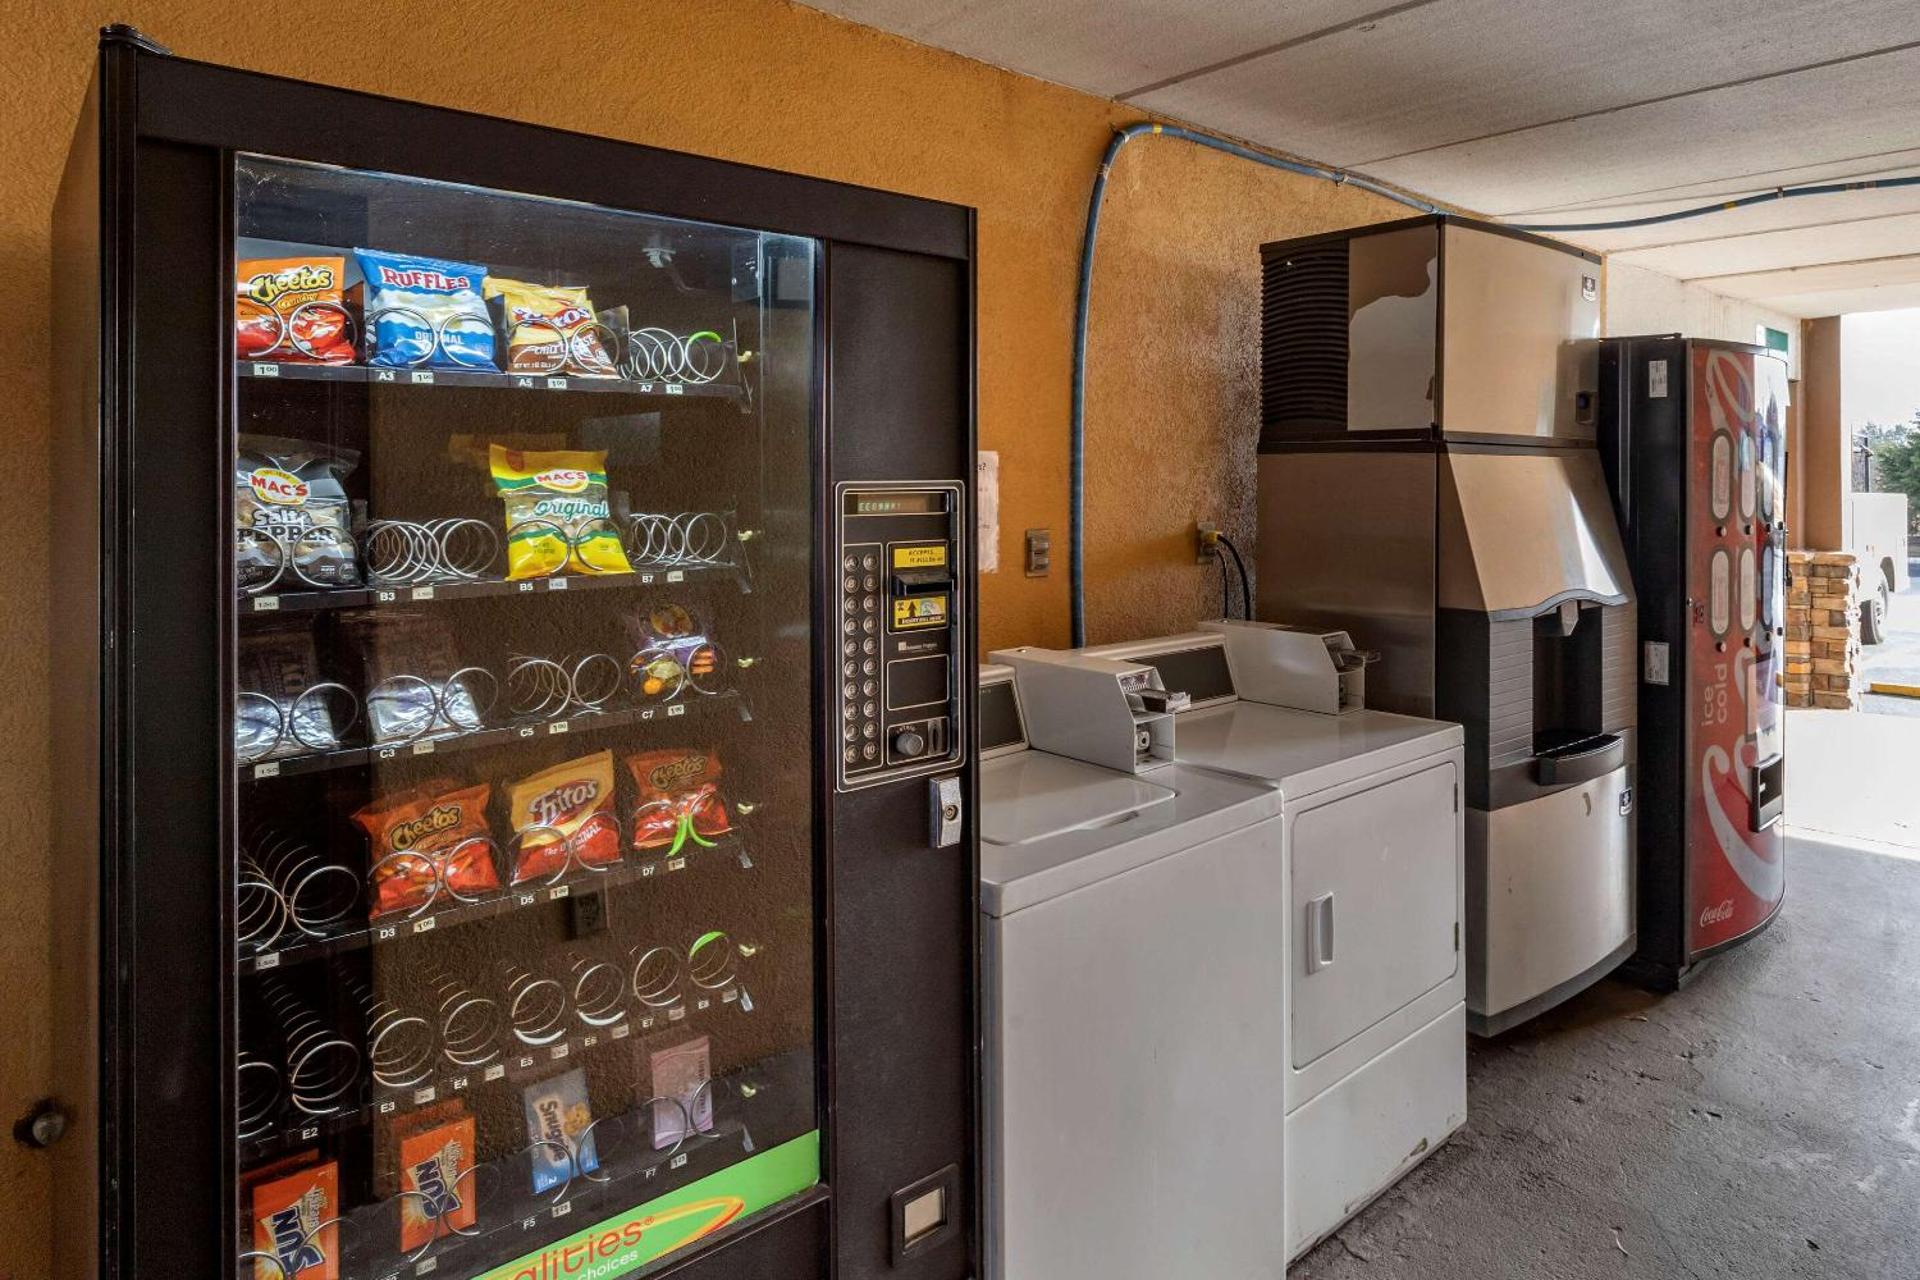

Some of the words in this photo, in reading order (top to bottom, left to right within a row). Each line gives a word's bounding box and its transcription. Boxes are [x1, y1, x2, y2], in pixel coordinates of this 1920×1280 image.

[248, 264, 333, 305] Cheetos
[379, 266, 470, 290] RUFFLES
[379, 372, 395, 381] A3
[536, 471, 586, 482] MAC'S
[250, 474, 308, 496] MAC'S
[534, 499, 608, 522] original
[380, 592, 395, 600] B3
[1714, 663, 1728, 724] cold
[1701, 686, 1714, 727] ice
[642, 710, 654, 719] C7
[520, 728, 534, 737] C5
[379, 749, 395, 758] C3
[529, 780, 598, 826] Fritos
[391, 807, 461, 852] Cheetos
[642, 867, 654, 876] D7
[520, 896, 534, 905] D5
[380, 928, 395, 939] D3
[454, 1078, 467, 1090] E4
[381, 1101, 395, 1113] E3
[302, 1127, 318, 1140] E2
[538, 1100, 569, 1163] Snuge
[413, 1157, 463, 1220] SUN
[523, 1218, 536, 1231] F5
[271, 1206, 325, 1273] SUN
